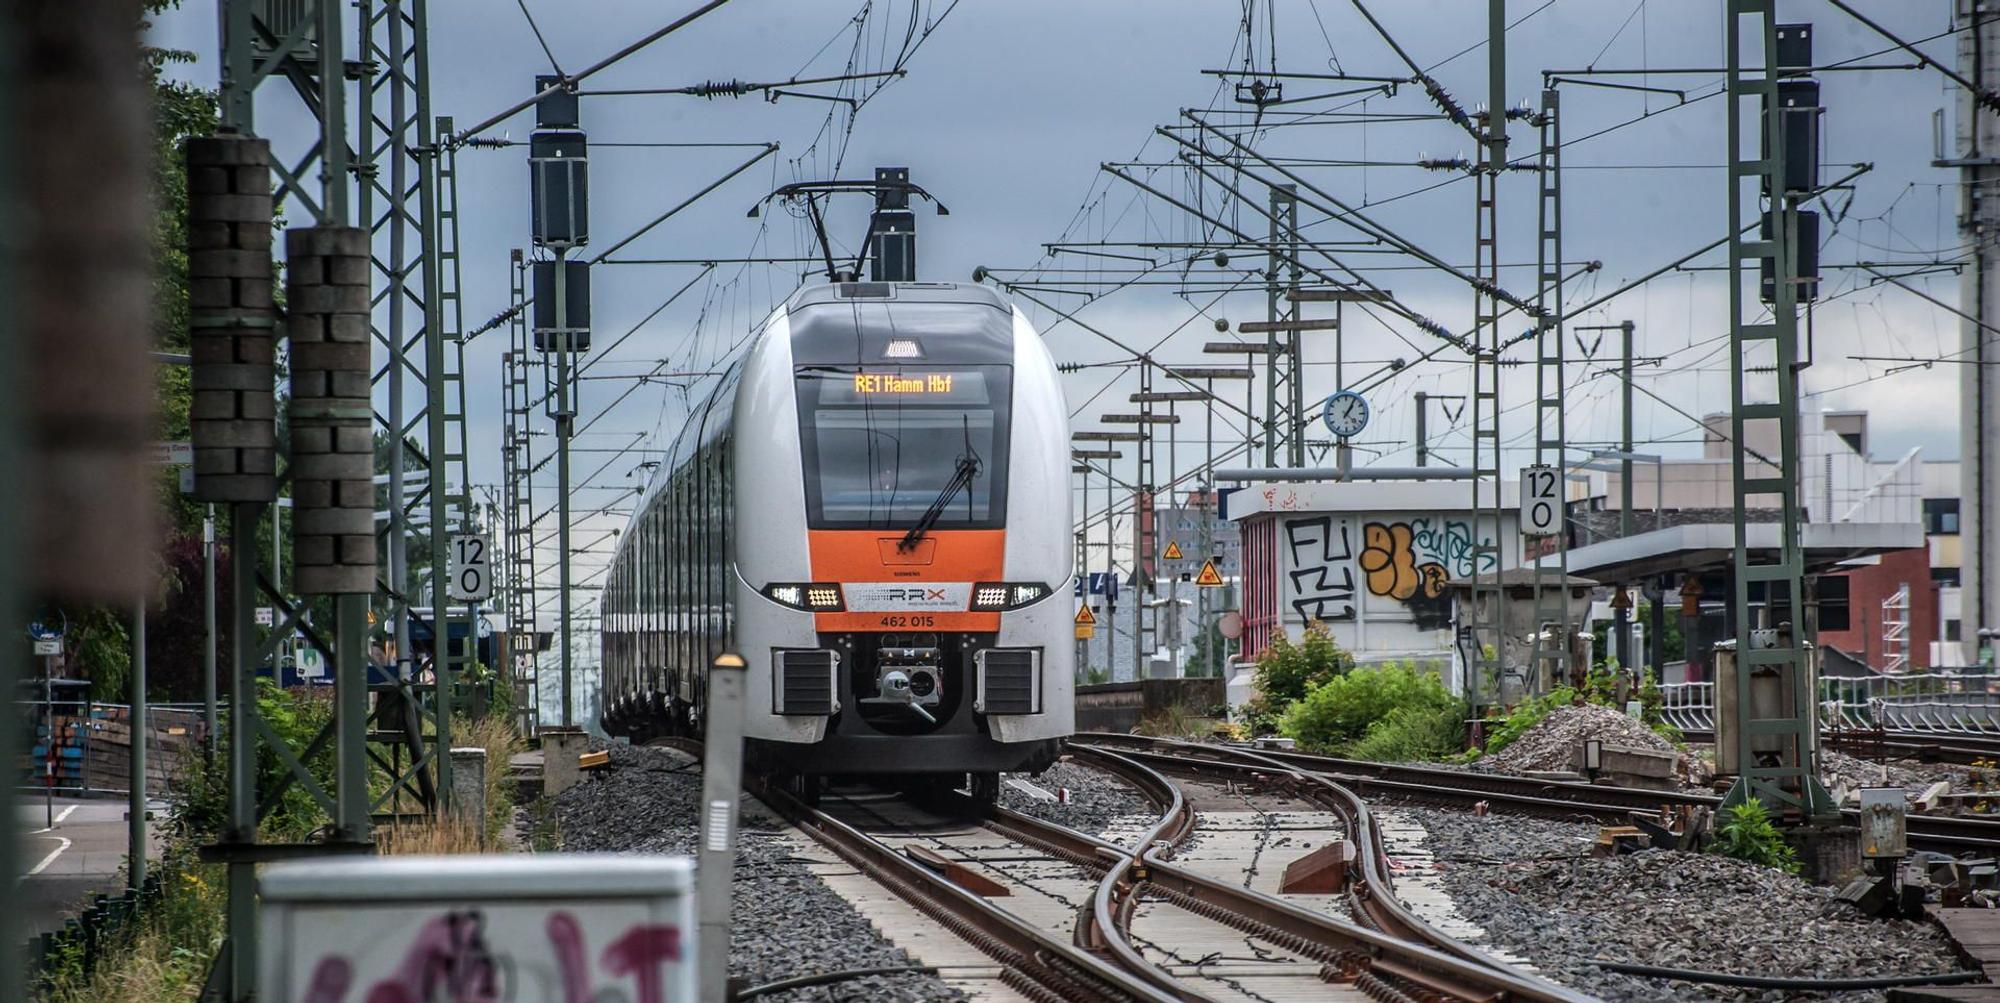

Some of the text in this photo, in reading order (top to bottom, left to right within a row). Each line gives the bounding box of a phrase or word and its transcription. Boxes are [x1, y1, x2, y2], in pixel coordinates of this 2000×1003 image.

[855, 375, 952, 392] RE1 Hamm Hbf
[1528, 471, 1555, 498] 12
[1532, 502, 1552, 528] 0
[457, 539, 484, 565] 12
[461, 568, 480, 593] 0
[889, 589, 945, 600] RRX
[881, 616, 934, 627] 462 015
